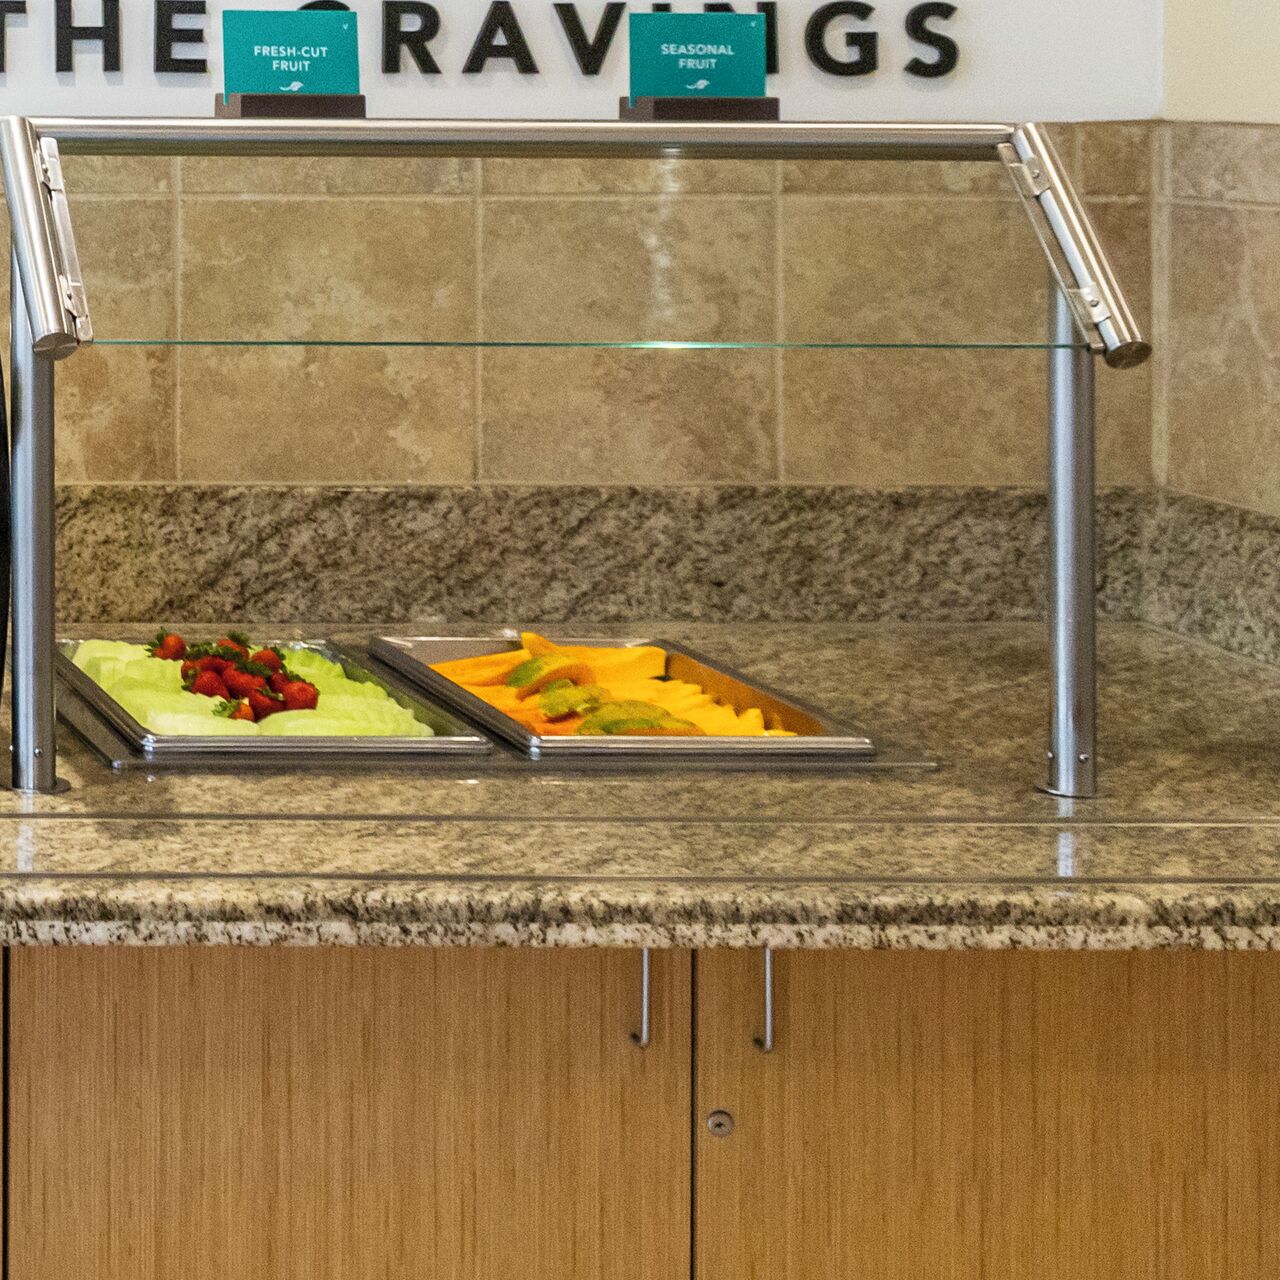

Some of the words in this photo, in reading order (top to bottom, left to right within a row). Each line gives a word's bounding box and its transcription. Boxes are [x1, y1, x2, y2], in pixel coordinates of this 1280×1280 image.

[295, 0, 962, 78] RAVGS
[253, 45, 329, 58] FRESH-CUT
[660, 43, 735, 56] SEASONAL
[272, 60, 311, 72] FRUIT
[678, 58, 718, 70] FRUIT
